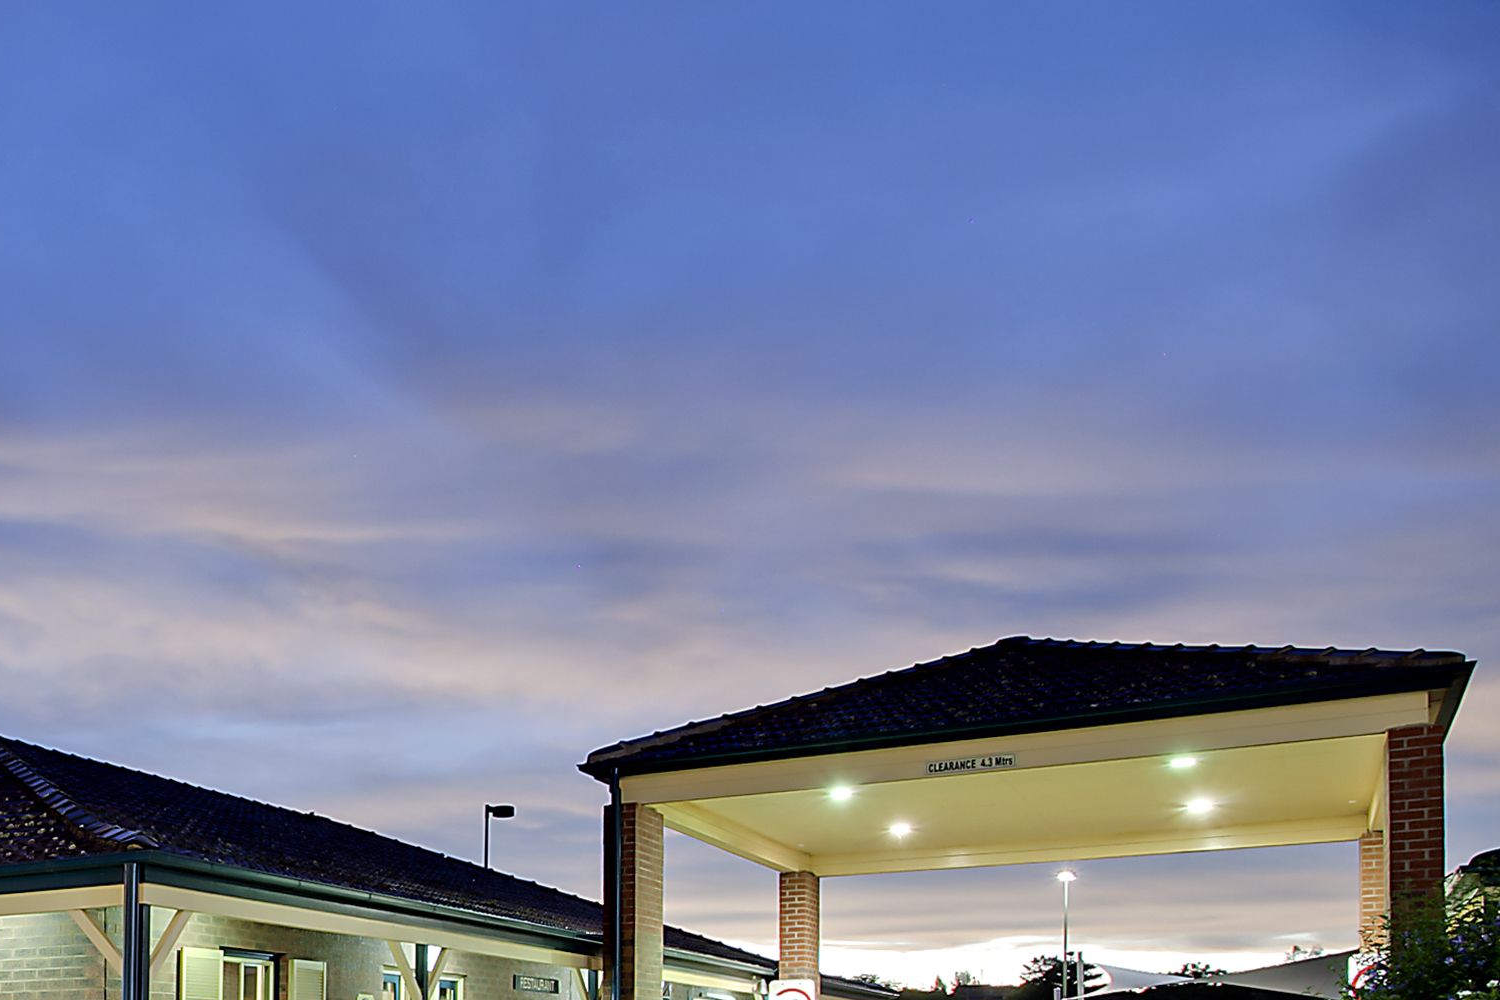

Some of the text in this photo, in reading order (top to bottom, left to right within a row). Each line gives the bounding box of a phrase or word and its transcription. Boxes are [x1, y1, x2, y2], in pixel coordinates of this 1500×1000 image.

[928, 756, 1013, 773] CLEARANCE 4.3 Mtrs
